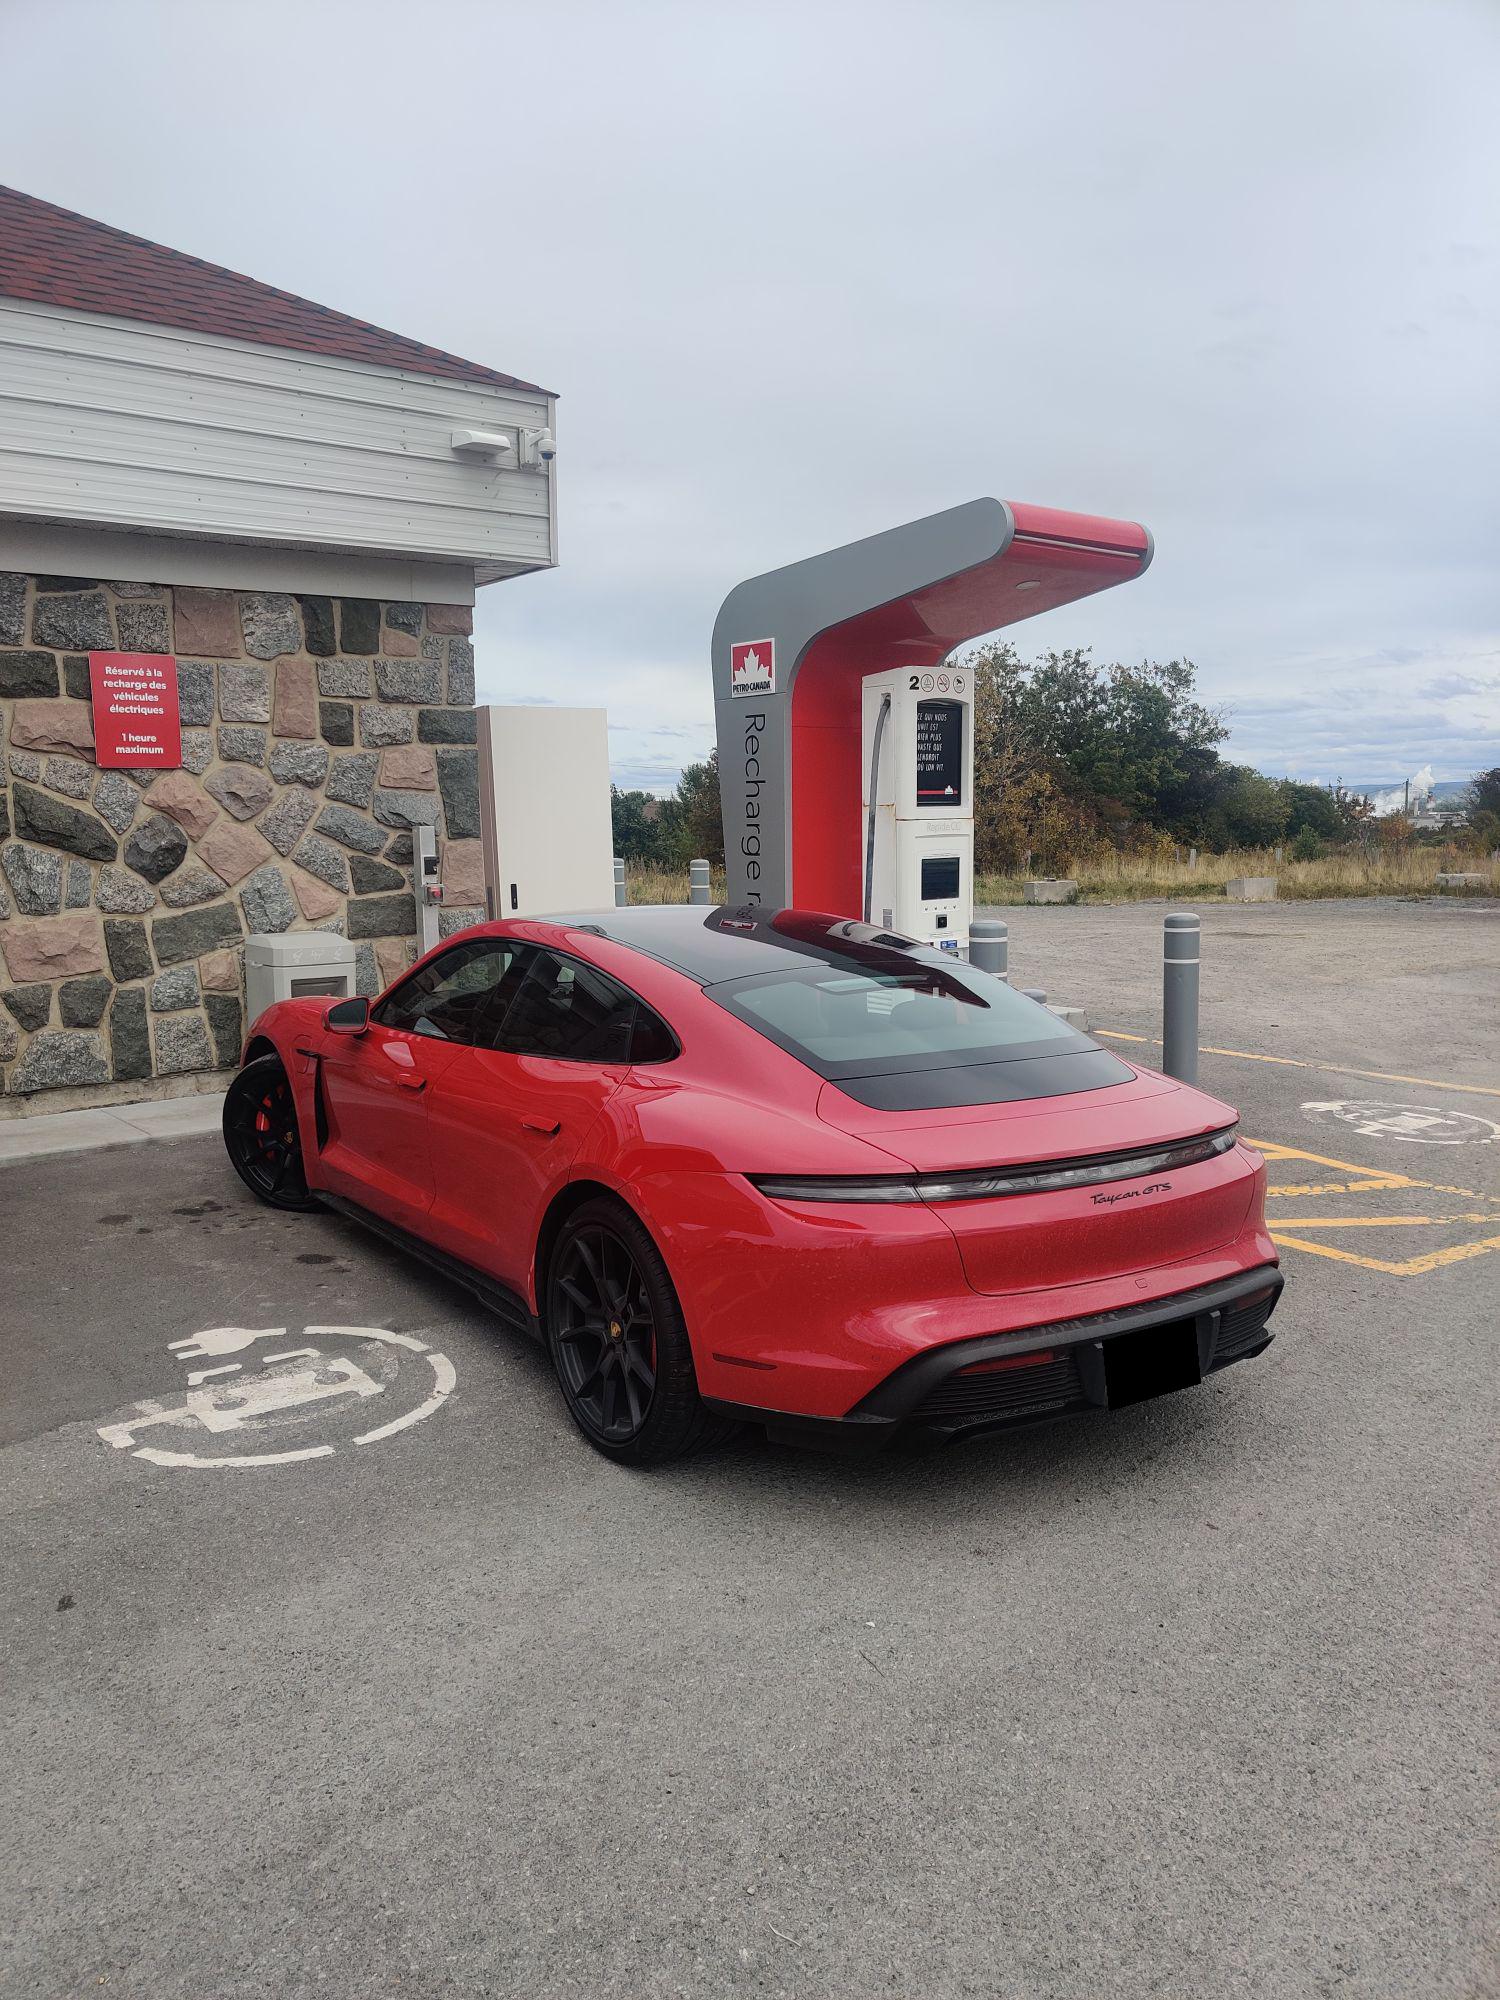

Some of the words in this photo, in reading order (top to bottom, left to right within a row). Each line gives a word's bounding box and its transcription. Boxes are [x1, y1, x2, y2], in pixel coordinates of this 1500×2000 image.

[105, 666, 144, 677] Réservé
[146, 668, 152, 677] à
[154, 668, 163, 677] la
[103, 680, 147, 690] recharge
[149, 681, 167, 690] des
[909, 675, 920, 690] 2
[113, 691, 159, 702] véhicules
[109, 704, 164, 715] électriques
[121, 733, 126, 741] 1
[128, 733, 157, 743] heure
[115, 745, 164, 754] maximum
[741, 713, 766, 880] Recharge
[1090, 1190, 1141, 1205] Taycan
[1142, 1182, 1173, 1195] GTS
